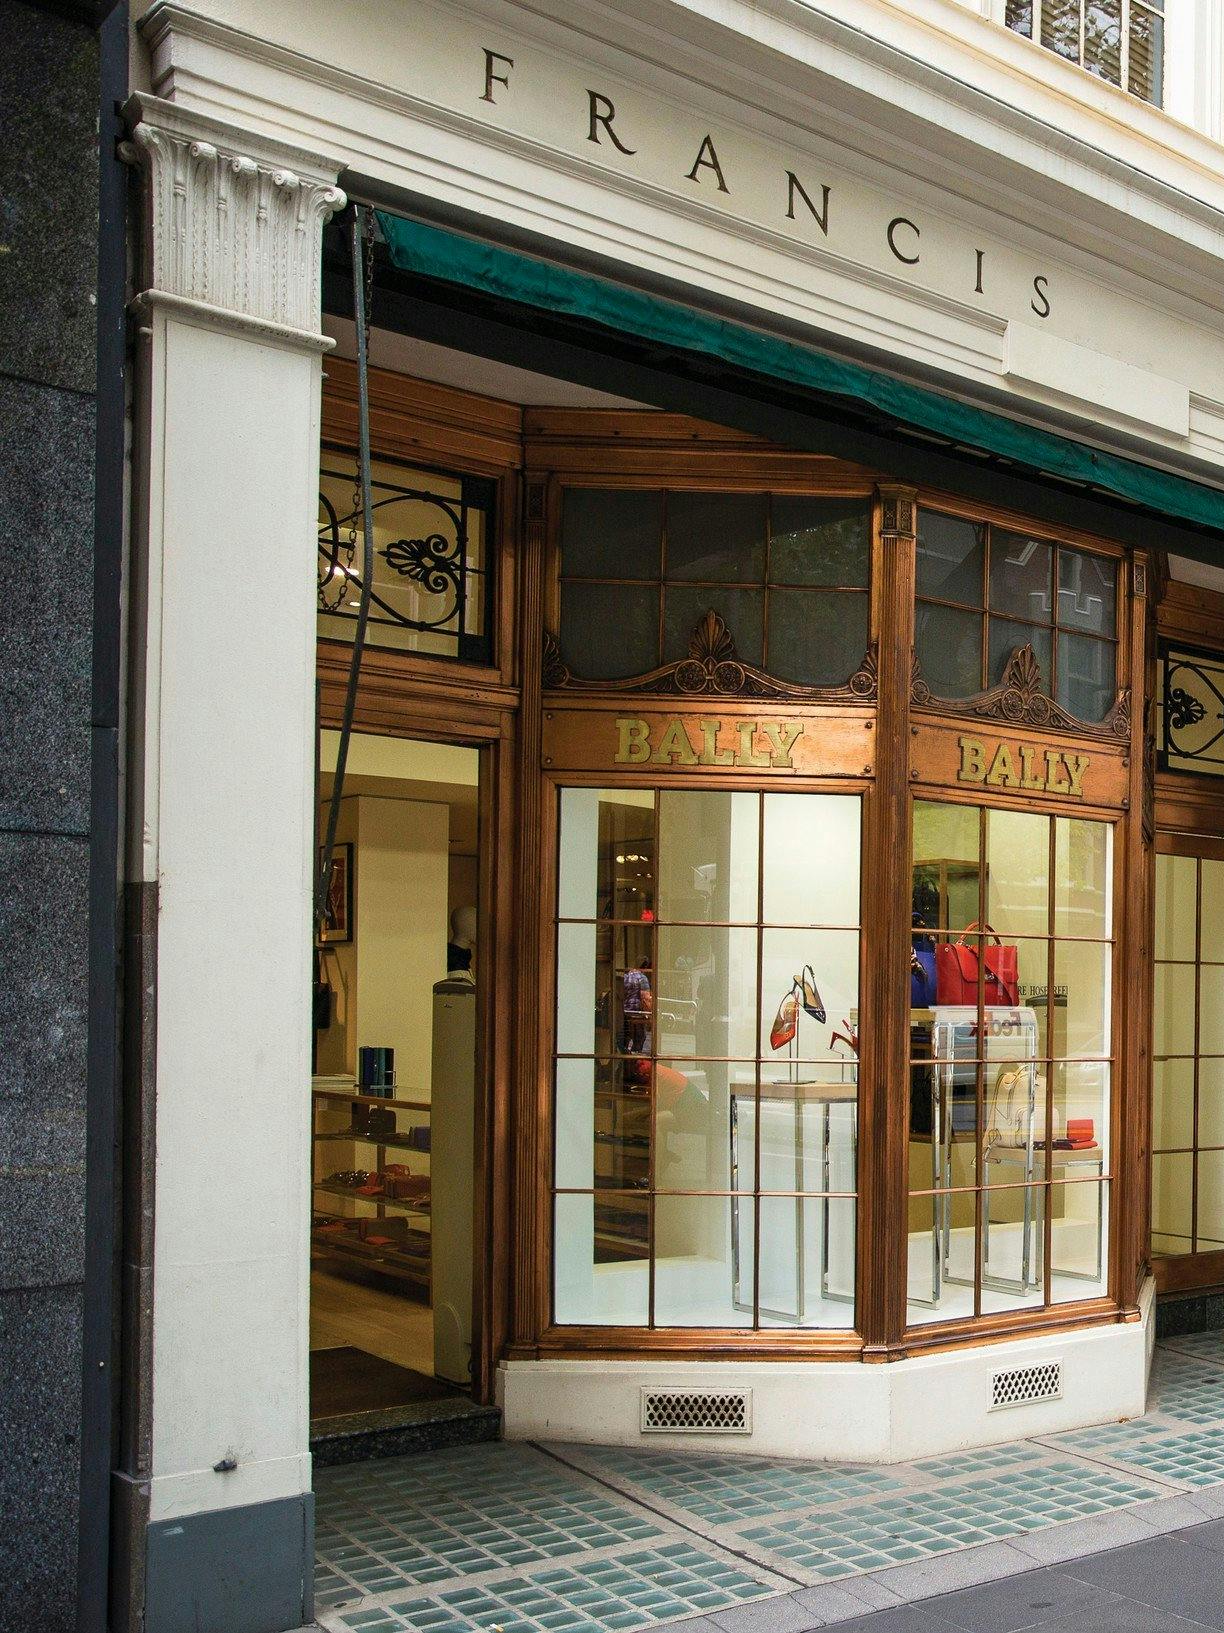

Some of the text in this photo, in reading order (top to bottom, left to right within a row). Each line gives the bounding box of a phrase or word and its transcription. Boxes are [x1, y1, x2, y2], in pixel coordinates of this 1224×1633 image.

[478, 46, 1050, 318] FRANCIS
[614, 718, 804, 768] BALLY
[957, 735, 1090, 797] BALLY
